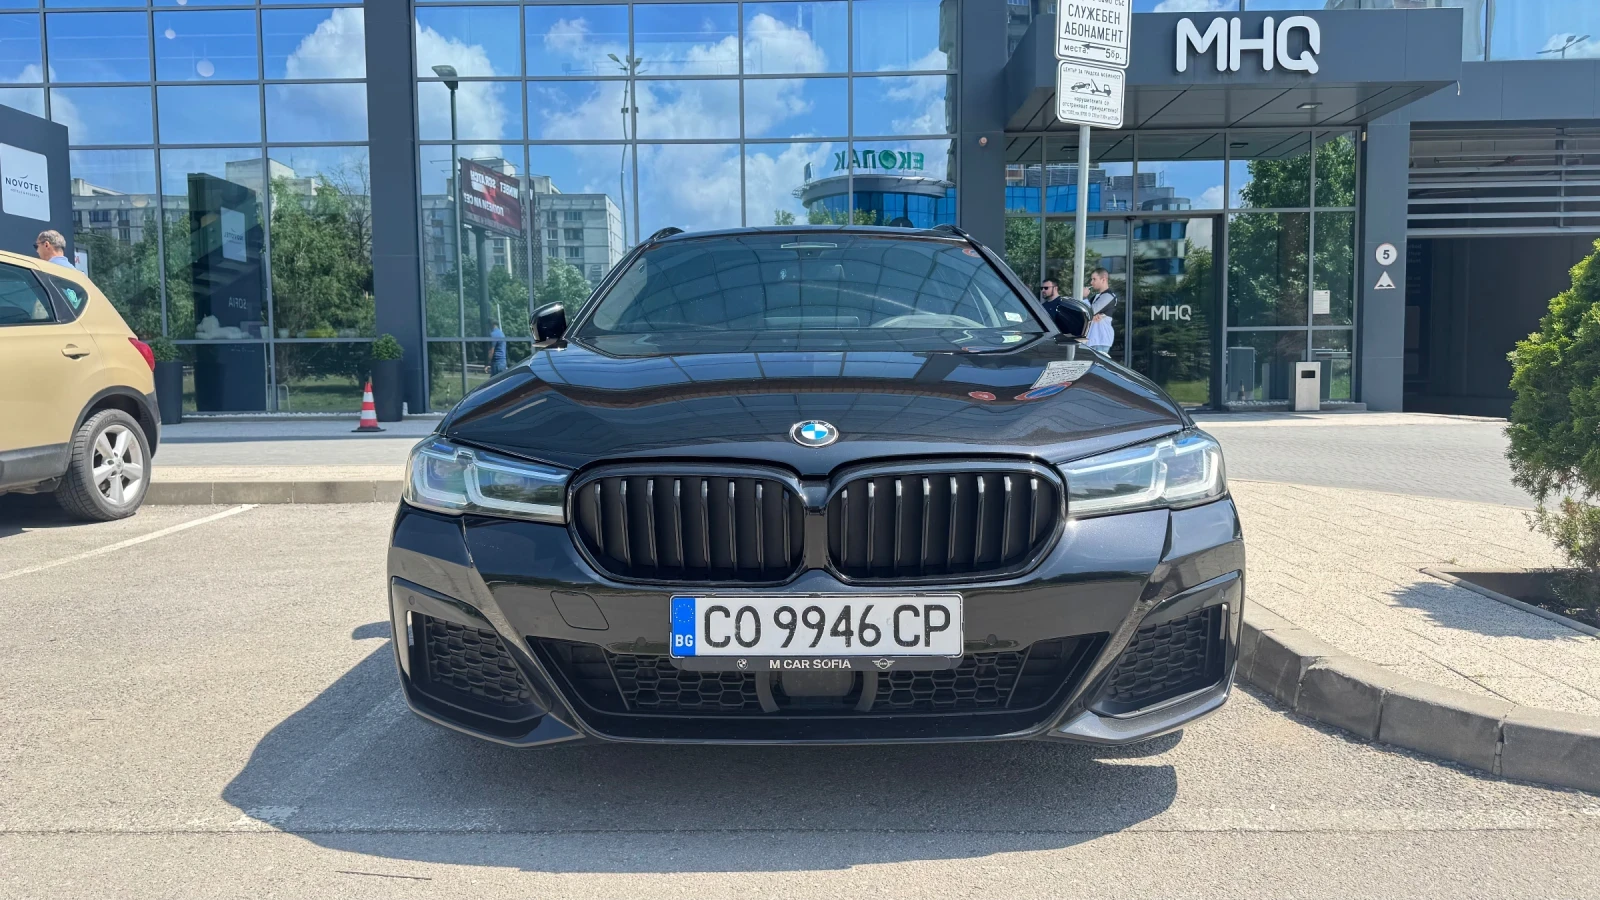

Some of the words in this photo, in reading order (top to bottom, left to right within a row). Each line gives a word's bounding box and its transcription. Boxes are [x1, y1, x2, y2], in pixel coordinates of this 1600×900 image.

[1068, 3, 1121, 25] СЛУЖЕБЕН
[1064, 21, 1124, 43] АБОНАМЕНТ
[1176, 15, 1320, 75] MHQ
[5, 176, 44, 194] NOVOTEL
[1382, 249, 1390, 260] 5
[1150, 304, 1192, 321] MHQ
[773, 604, 882, 649] 9946
[893, 604, 951, 648] CP
[675, 634, 694, 648] BG
[769, 659, 781, 669] M
[783, 659, 810, 669] CAR
[812, 659, 852, 669] SOFIA
